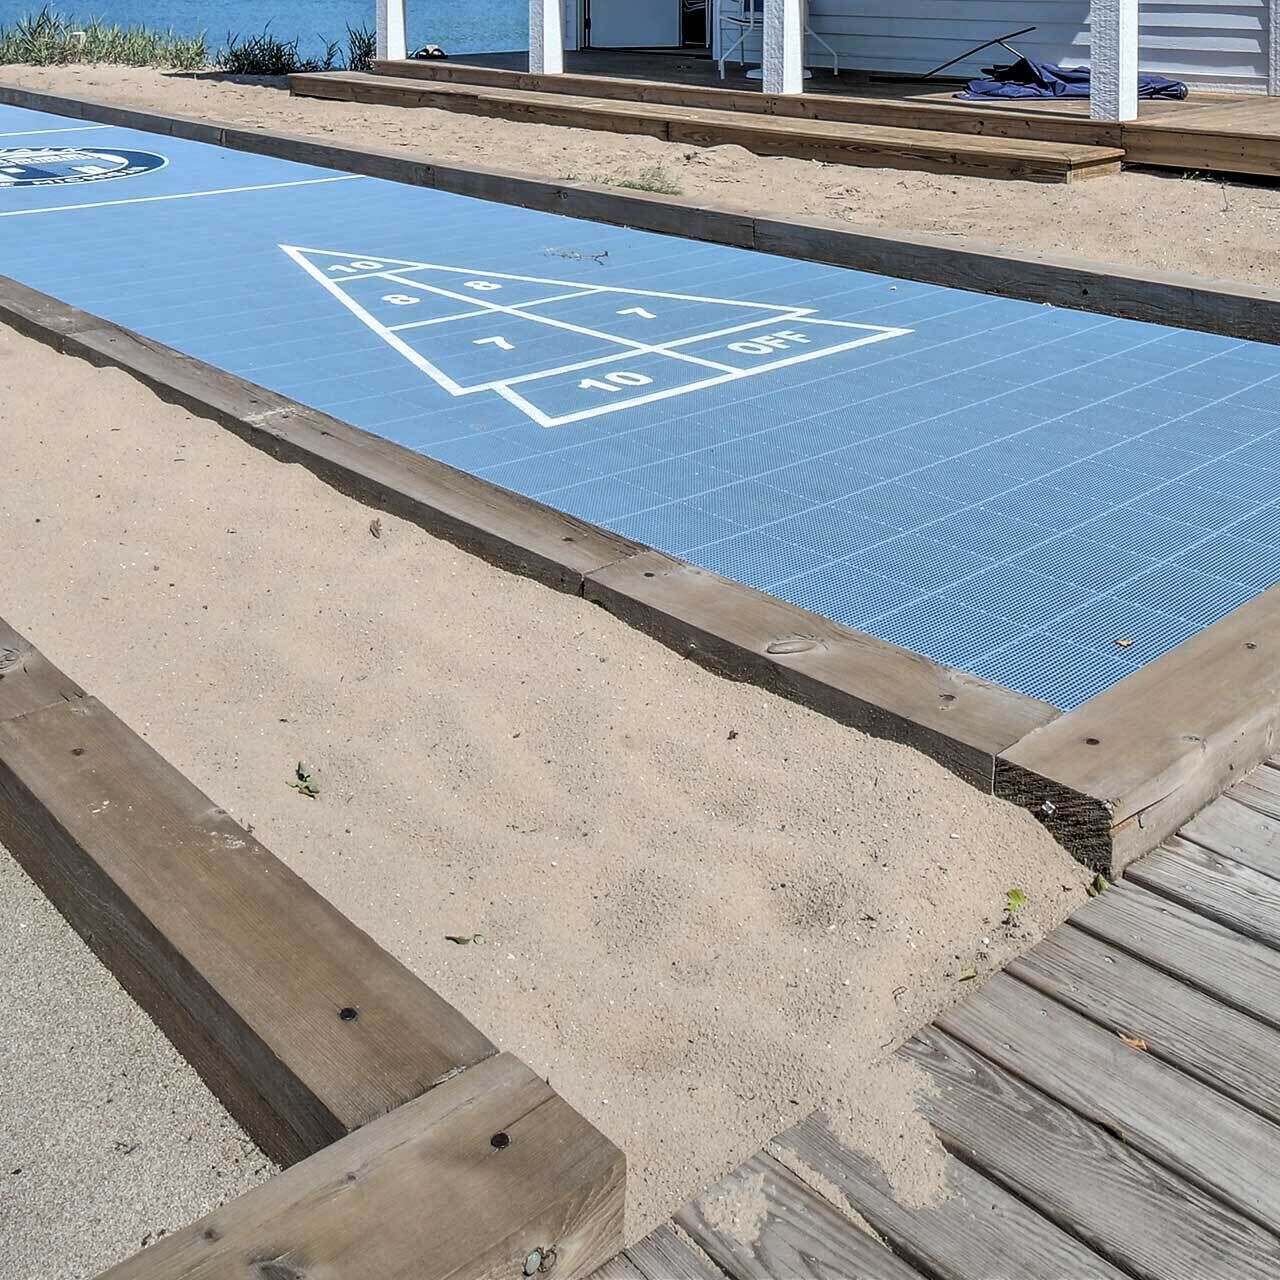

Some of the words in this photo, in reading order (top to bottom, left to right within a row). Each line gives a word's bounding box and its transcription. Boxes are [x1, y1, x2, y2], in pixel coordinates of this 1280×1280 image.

[327, 261, 385, 273] 10
[463, 280, 503, 291] 8
[381, 294, 421, 305] 8
[616, 306, 658, 319] 7
[472, 335, 515, 351] 7
[727, 330, 812, 355] OFF
[577, 371, 654, 393] 10
